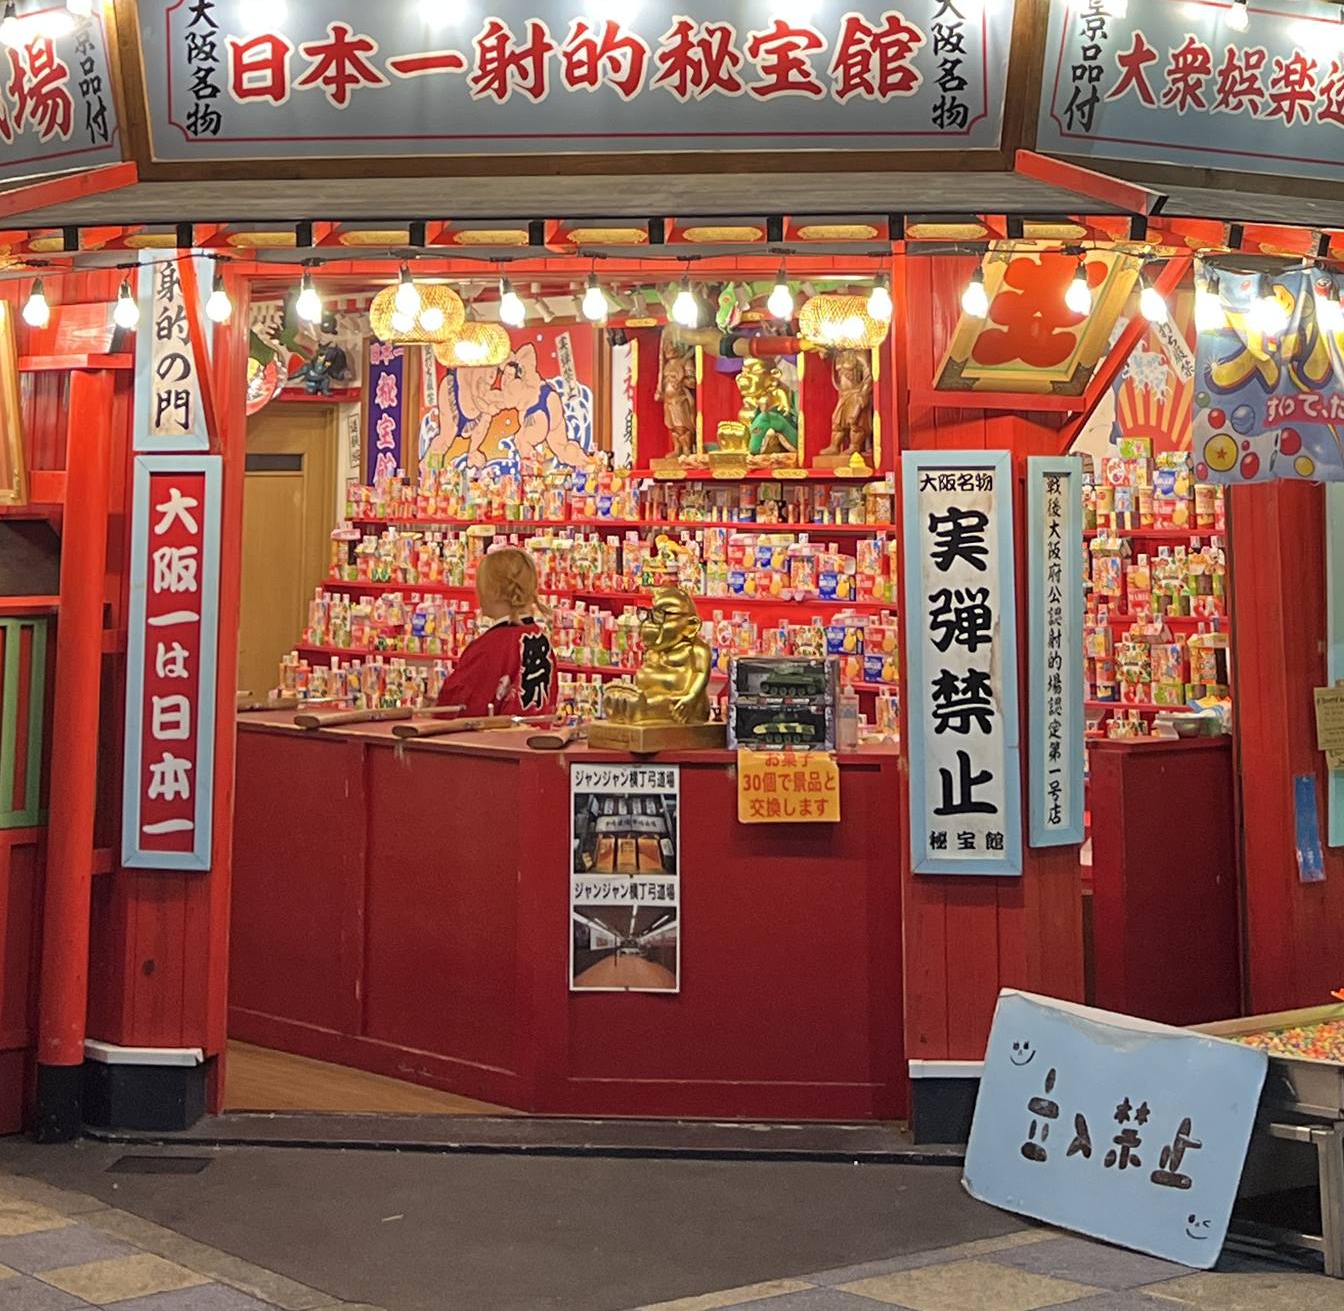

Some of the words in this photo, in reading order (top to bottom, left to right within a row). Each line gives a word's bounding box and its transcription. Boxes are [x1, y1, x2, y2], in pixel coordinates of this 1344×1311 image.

[229, 12, 928, 106] 日本一射的秘宝館
[919, 472, 994, 493] 大阪名物
[142, 487, 201, 837] 大阪一は日本一
[927, 506, 999, 817] 実弾禁止
[574, 769, 676, 789] ジャンジャン横丁弓道場
[742, 770, 837, 793] 30個で景品と
[749, 796, 830, 818] 交換します
[928, 830, 1005, 851] 秘宝館
[574, 882, 676, 902] ジャンジャン横丁弓道場
[1020, 1067, 1204, 1191] 立入禁止
